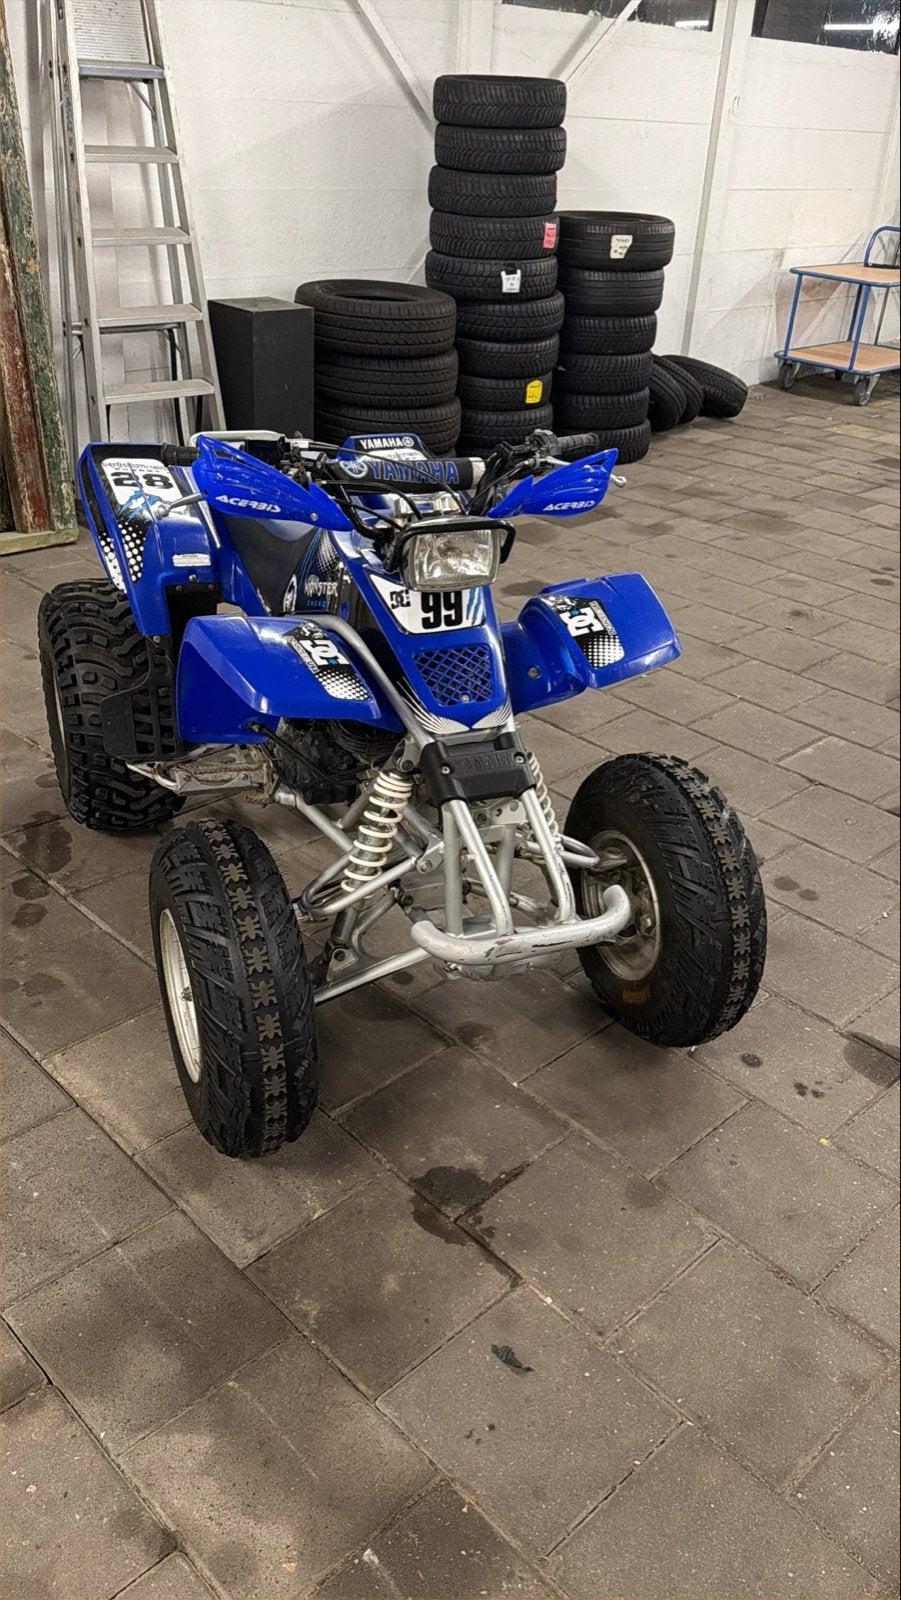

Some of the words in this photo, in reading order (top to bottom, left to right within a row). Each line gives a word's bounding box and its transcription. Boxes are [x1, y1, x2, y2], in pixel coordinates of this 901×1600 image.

[359, 437, 403, 450] YAMAHA
[111, 471, 174, 489] 28
[366, 459, 460, 484] YAMAHA
[215, 494, 281, 513] ACERBIS
[543, 499, 596, 512] ACERBIS
[421, 590, 463, 630] 99
